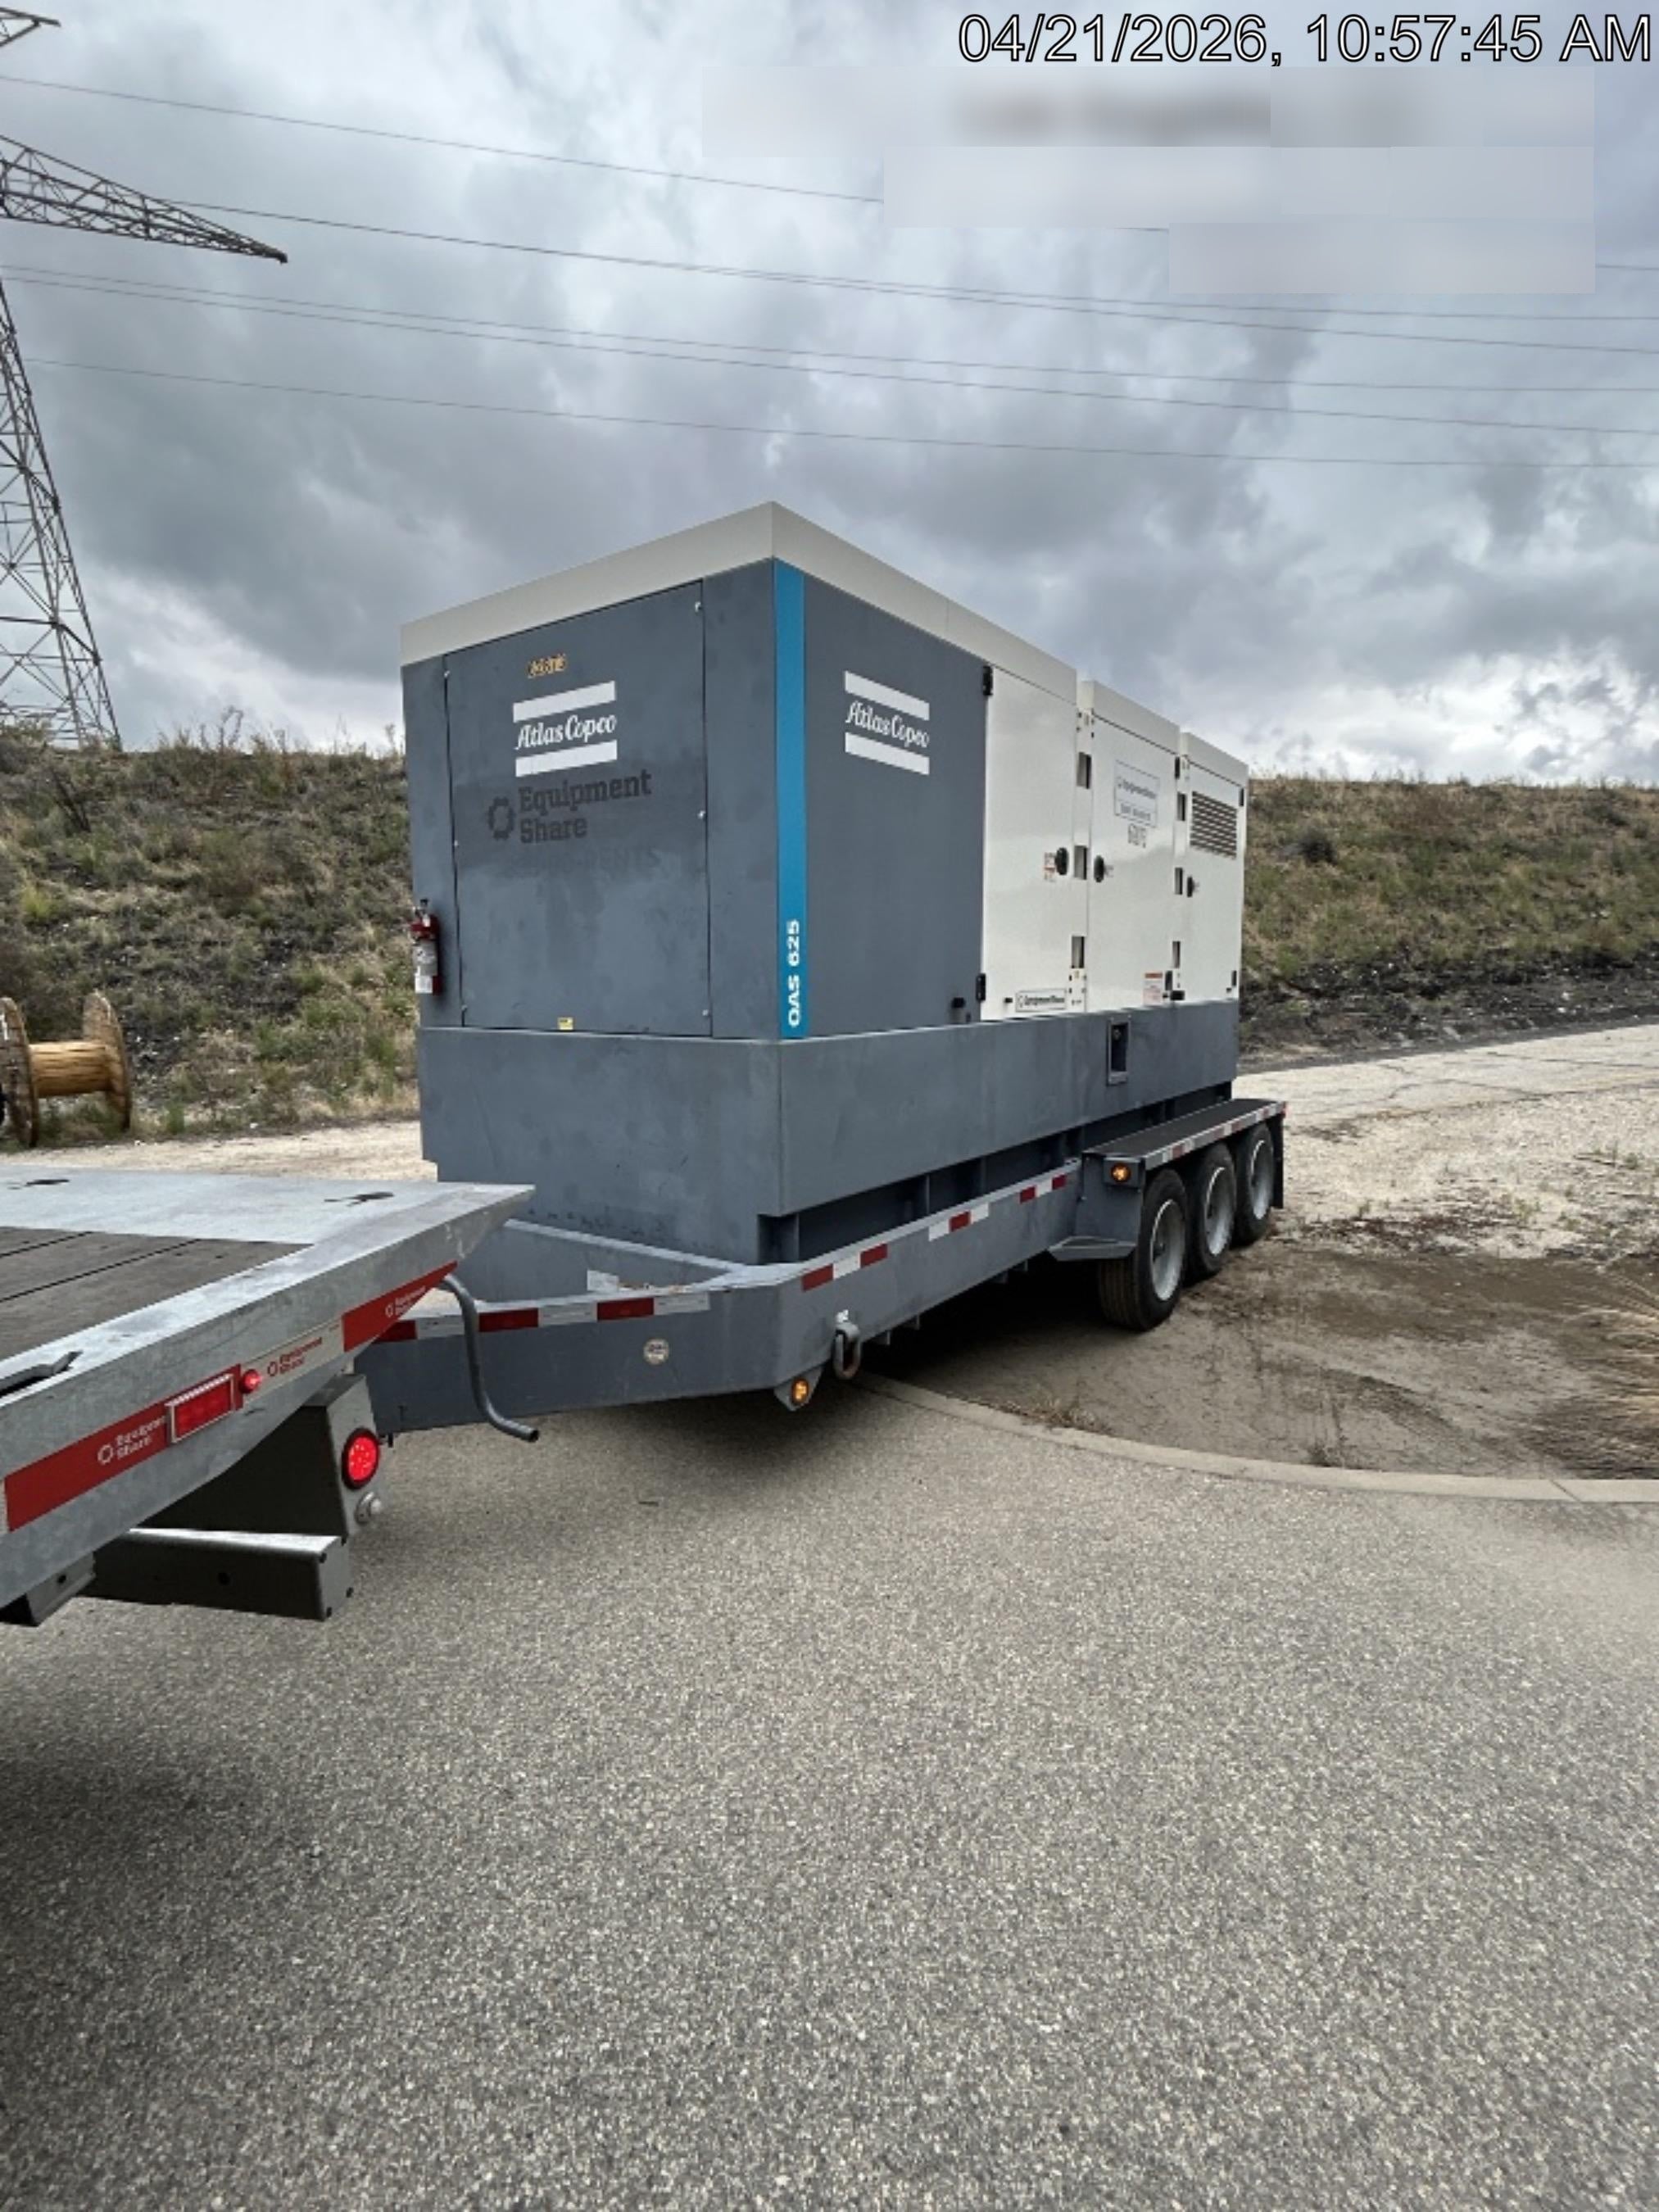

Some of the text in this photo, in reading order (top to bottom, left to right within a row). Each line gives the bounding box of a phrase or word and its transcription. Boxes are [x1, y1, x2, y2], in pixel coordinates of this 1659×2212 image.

[514, 714, 617, 750] Atlas Copco
[845, 700, 930, 748] Atlas Copco
[519, 768, 652, 817] Equipment
[519, 817, 588, 845] Share
[786, 918, 800, 1027] QAS 625
